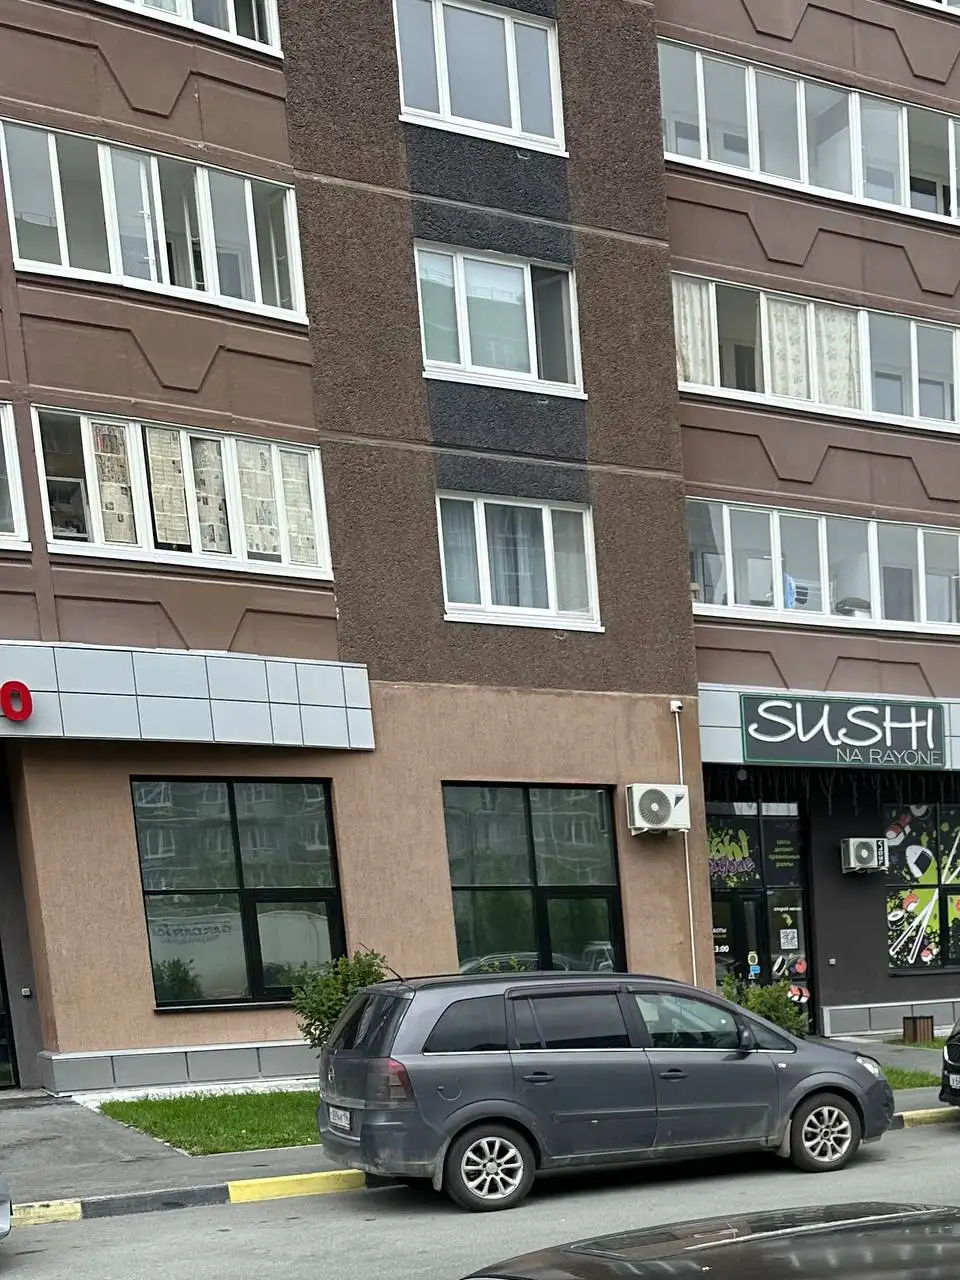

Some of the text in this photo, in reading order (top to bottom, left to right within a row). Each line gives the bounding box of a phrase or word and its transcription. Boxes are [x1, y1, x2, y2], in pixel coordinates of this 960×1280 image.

[748, 699, 936, 751] SUSHI
[836, 749, 943, 767] NA RAYONE
